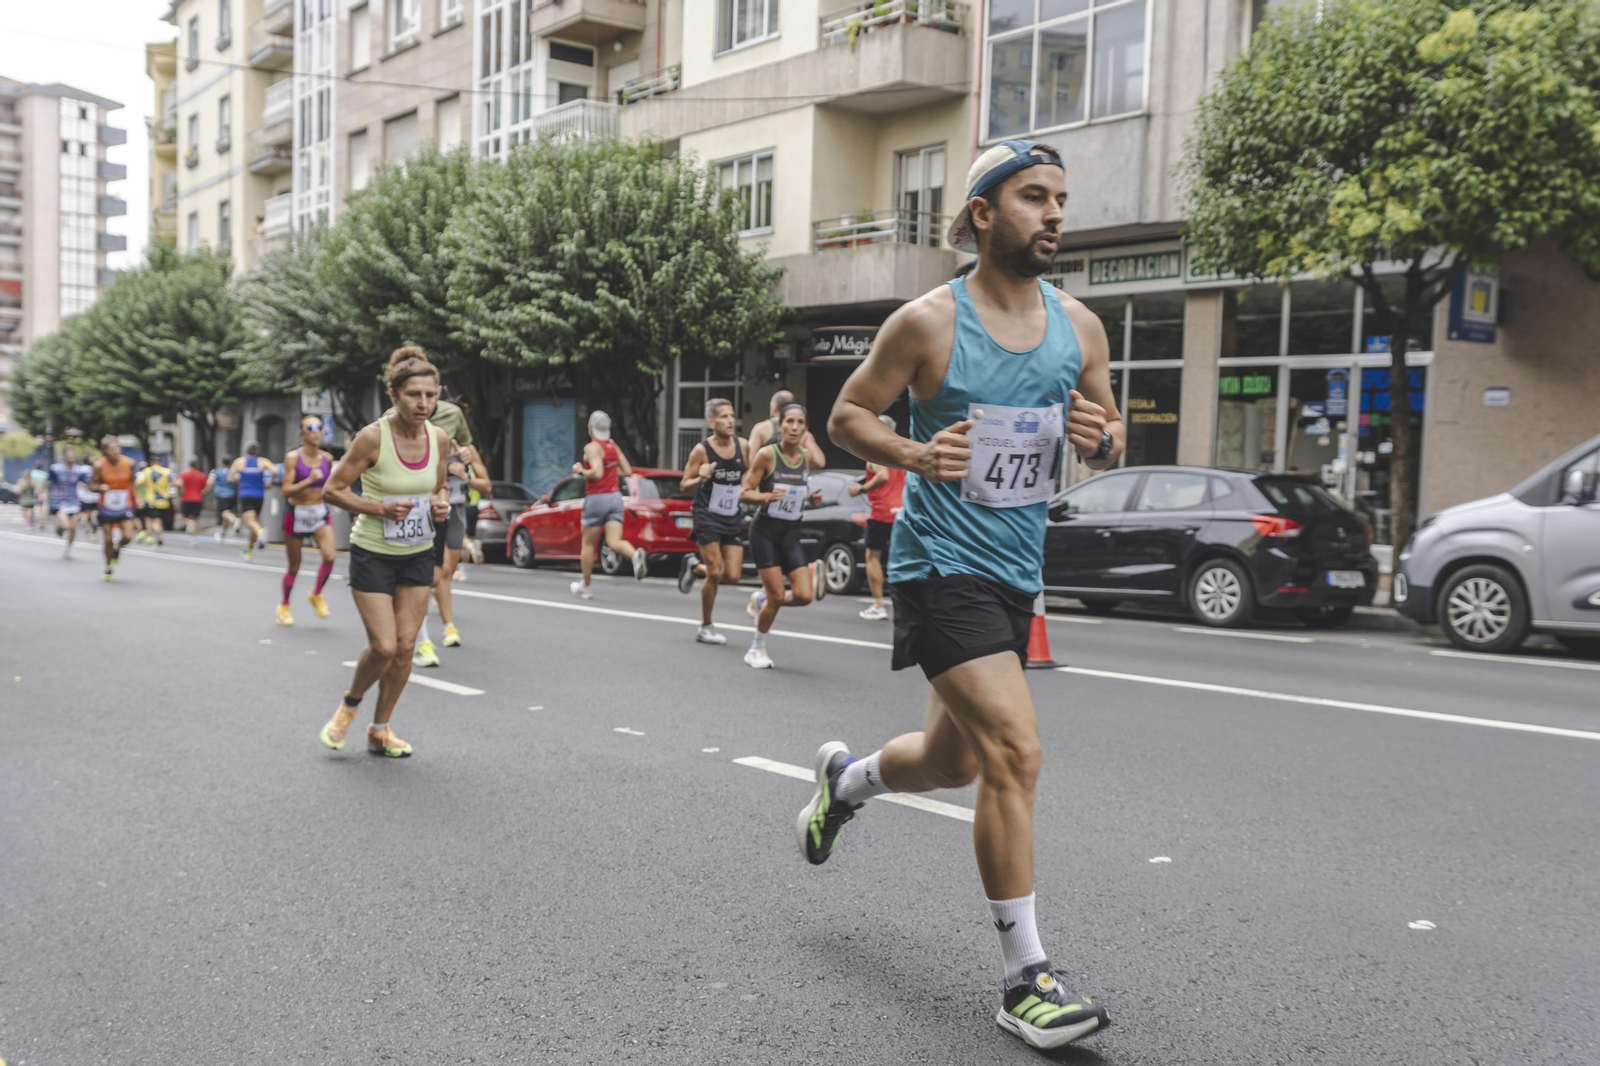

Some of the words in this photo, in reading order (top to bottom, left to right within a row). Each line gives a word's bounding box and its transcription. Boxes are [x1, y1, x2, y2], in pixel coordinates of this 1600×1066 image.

[1091, 253, 1179, 283] DECORACION
[977, 436, 1017, 448] MIGUEL
[984, 453, 1042, 489] 473
[778, 500, 796, 513] 142
[395, 518, 424, 538] 336
